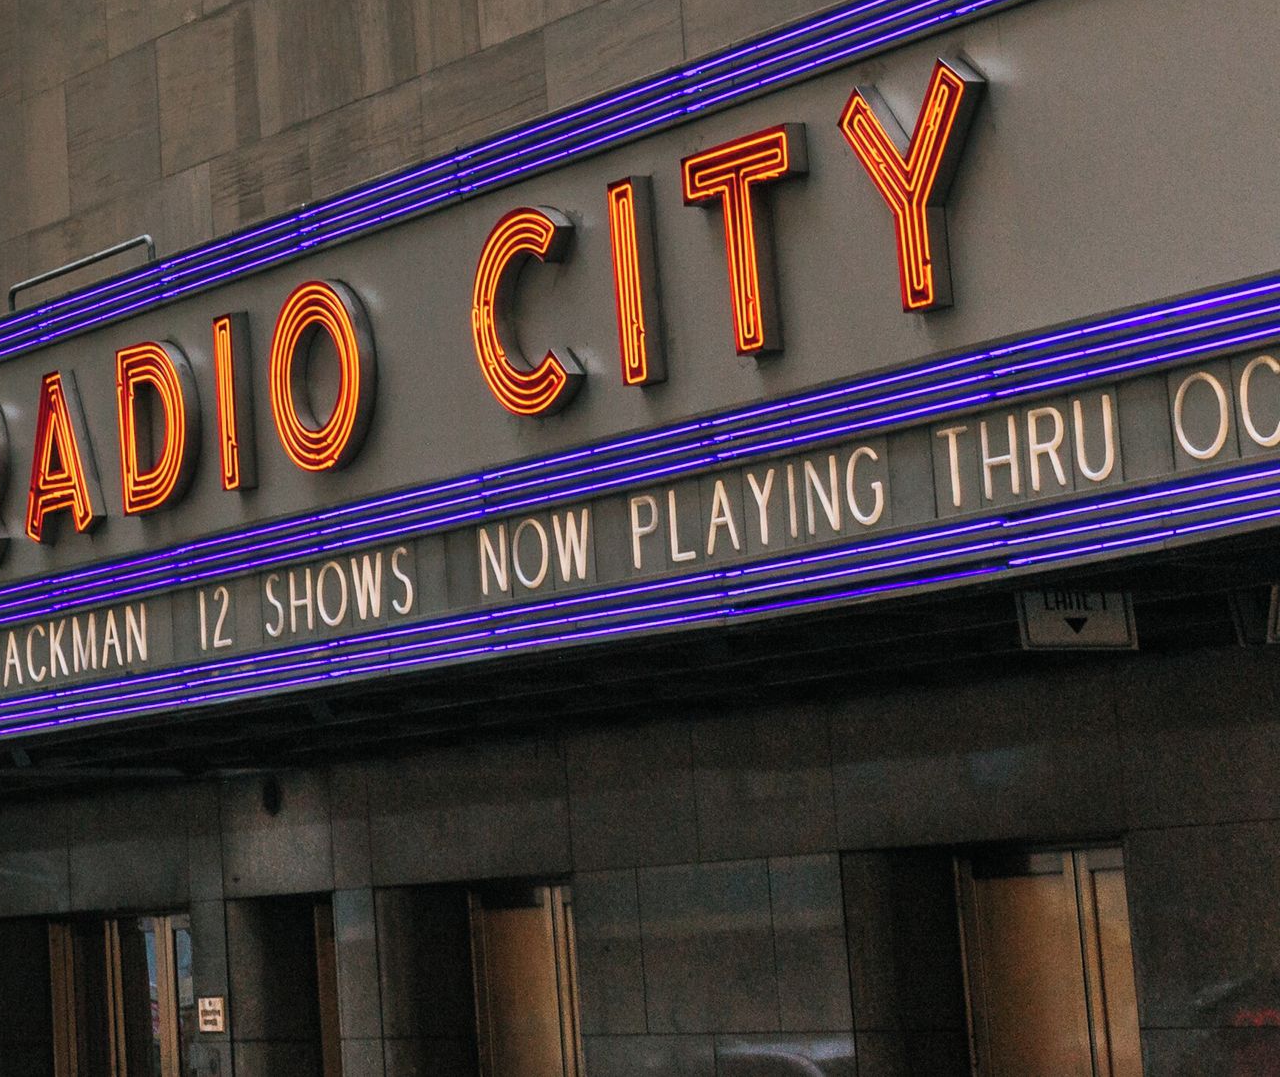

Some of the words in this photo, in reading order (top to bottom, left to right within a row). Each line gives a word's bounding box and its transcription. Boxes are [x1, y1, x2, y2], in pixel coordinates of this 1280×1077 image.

[471, 57, 984, 418] CITY
[198, 586, 233, 651] 12
[265, 545, 414, 638] SHOWS
[479, 507, 589, 597] NOW
[630, 445, 885, 569] PLAYING
[936, 394, 1115, 508] THRU
